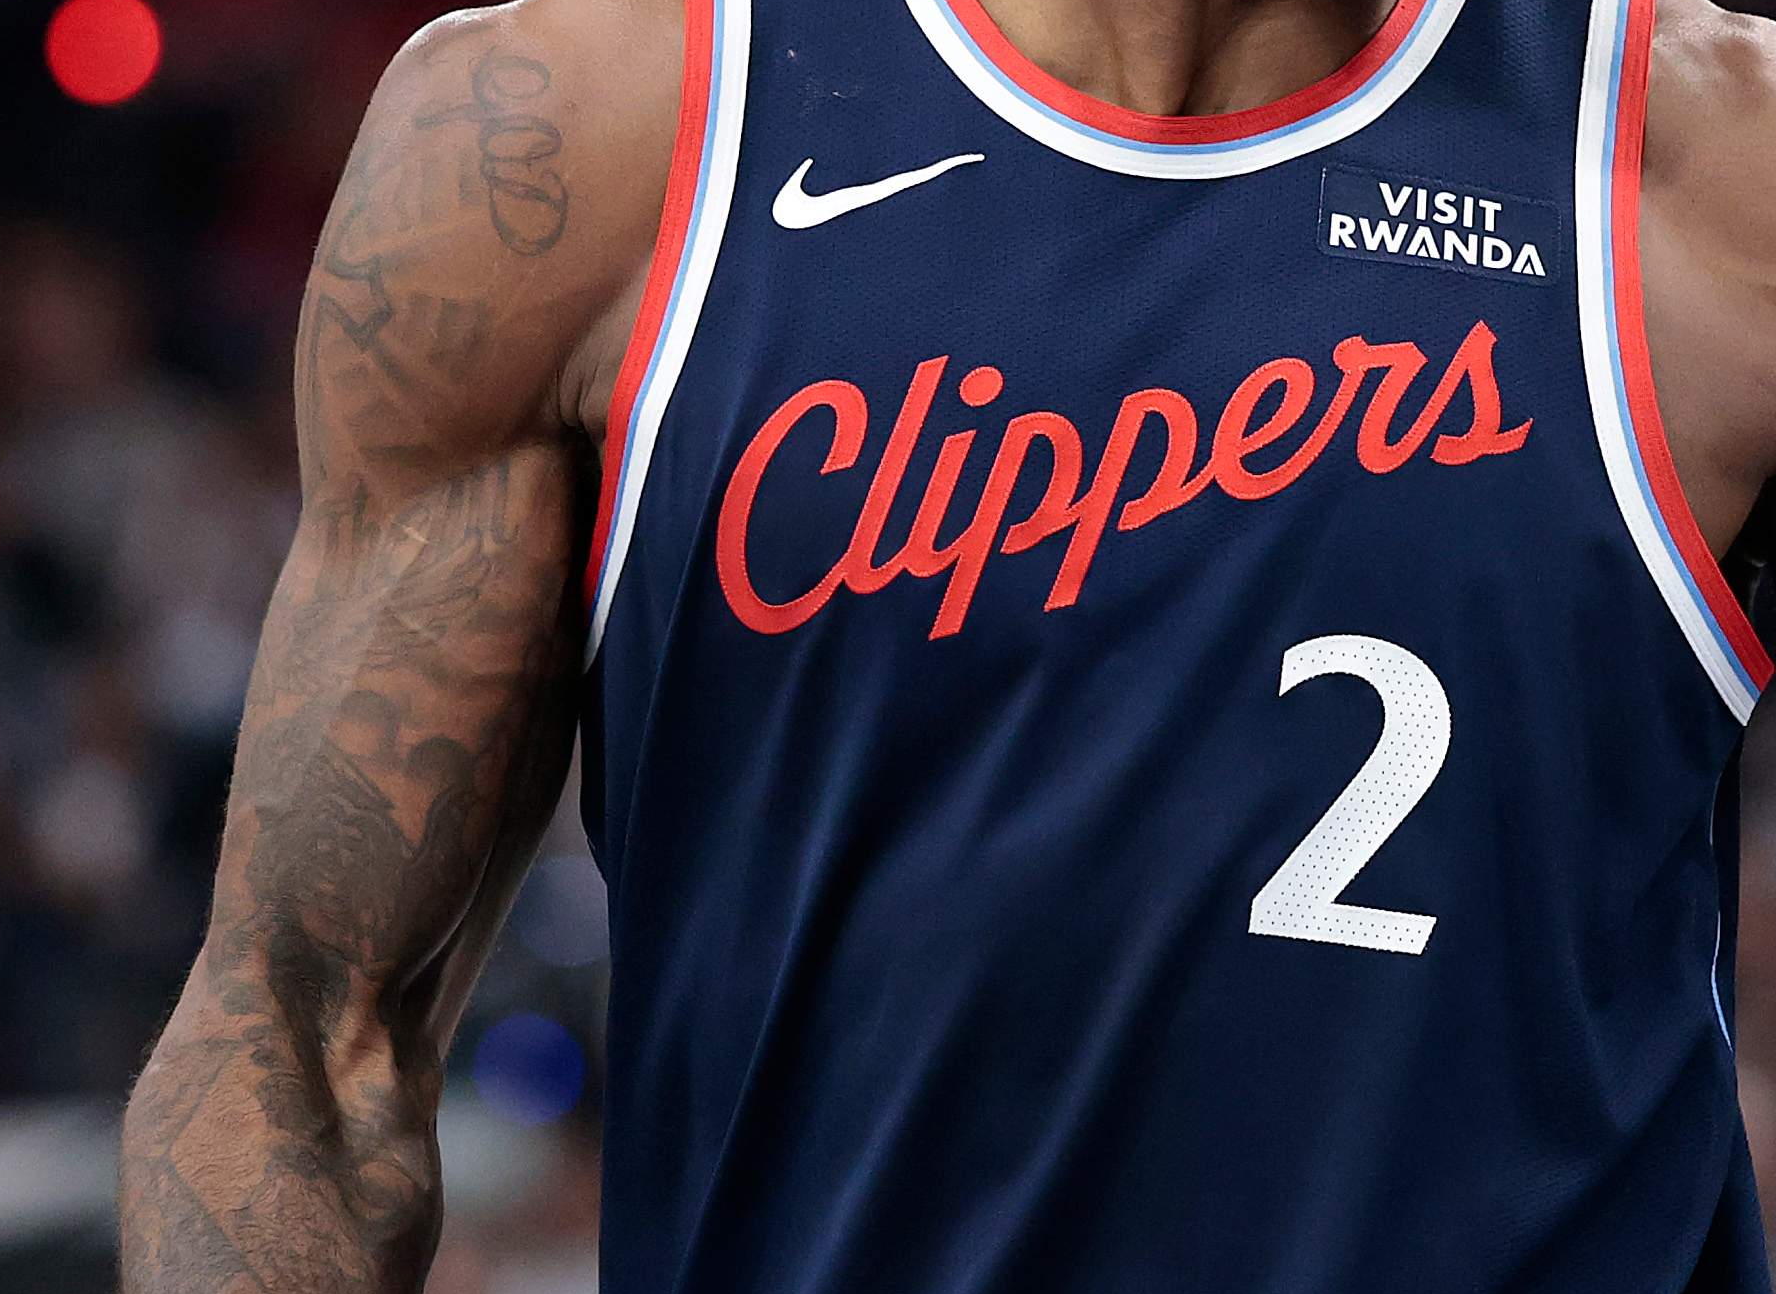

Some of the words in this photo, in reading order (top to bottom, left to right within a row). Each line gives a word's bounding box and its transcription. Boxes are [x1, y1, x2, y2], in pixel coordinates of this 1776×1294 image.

[1328, 212, 1547, 278] RWANDA
[1378, 182, 1503, 232] VISIT
[716, 320, 1534, 641] Clippers
[1247, 634, 1453, 956] 2
